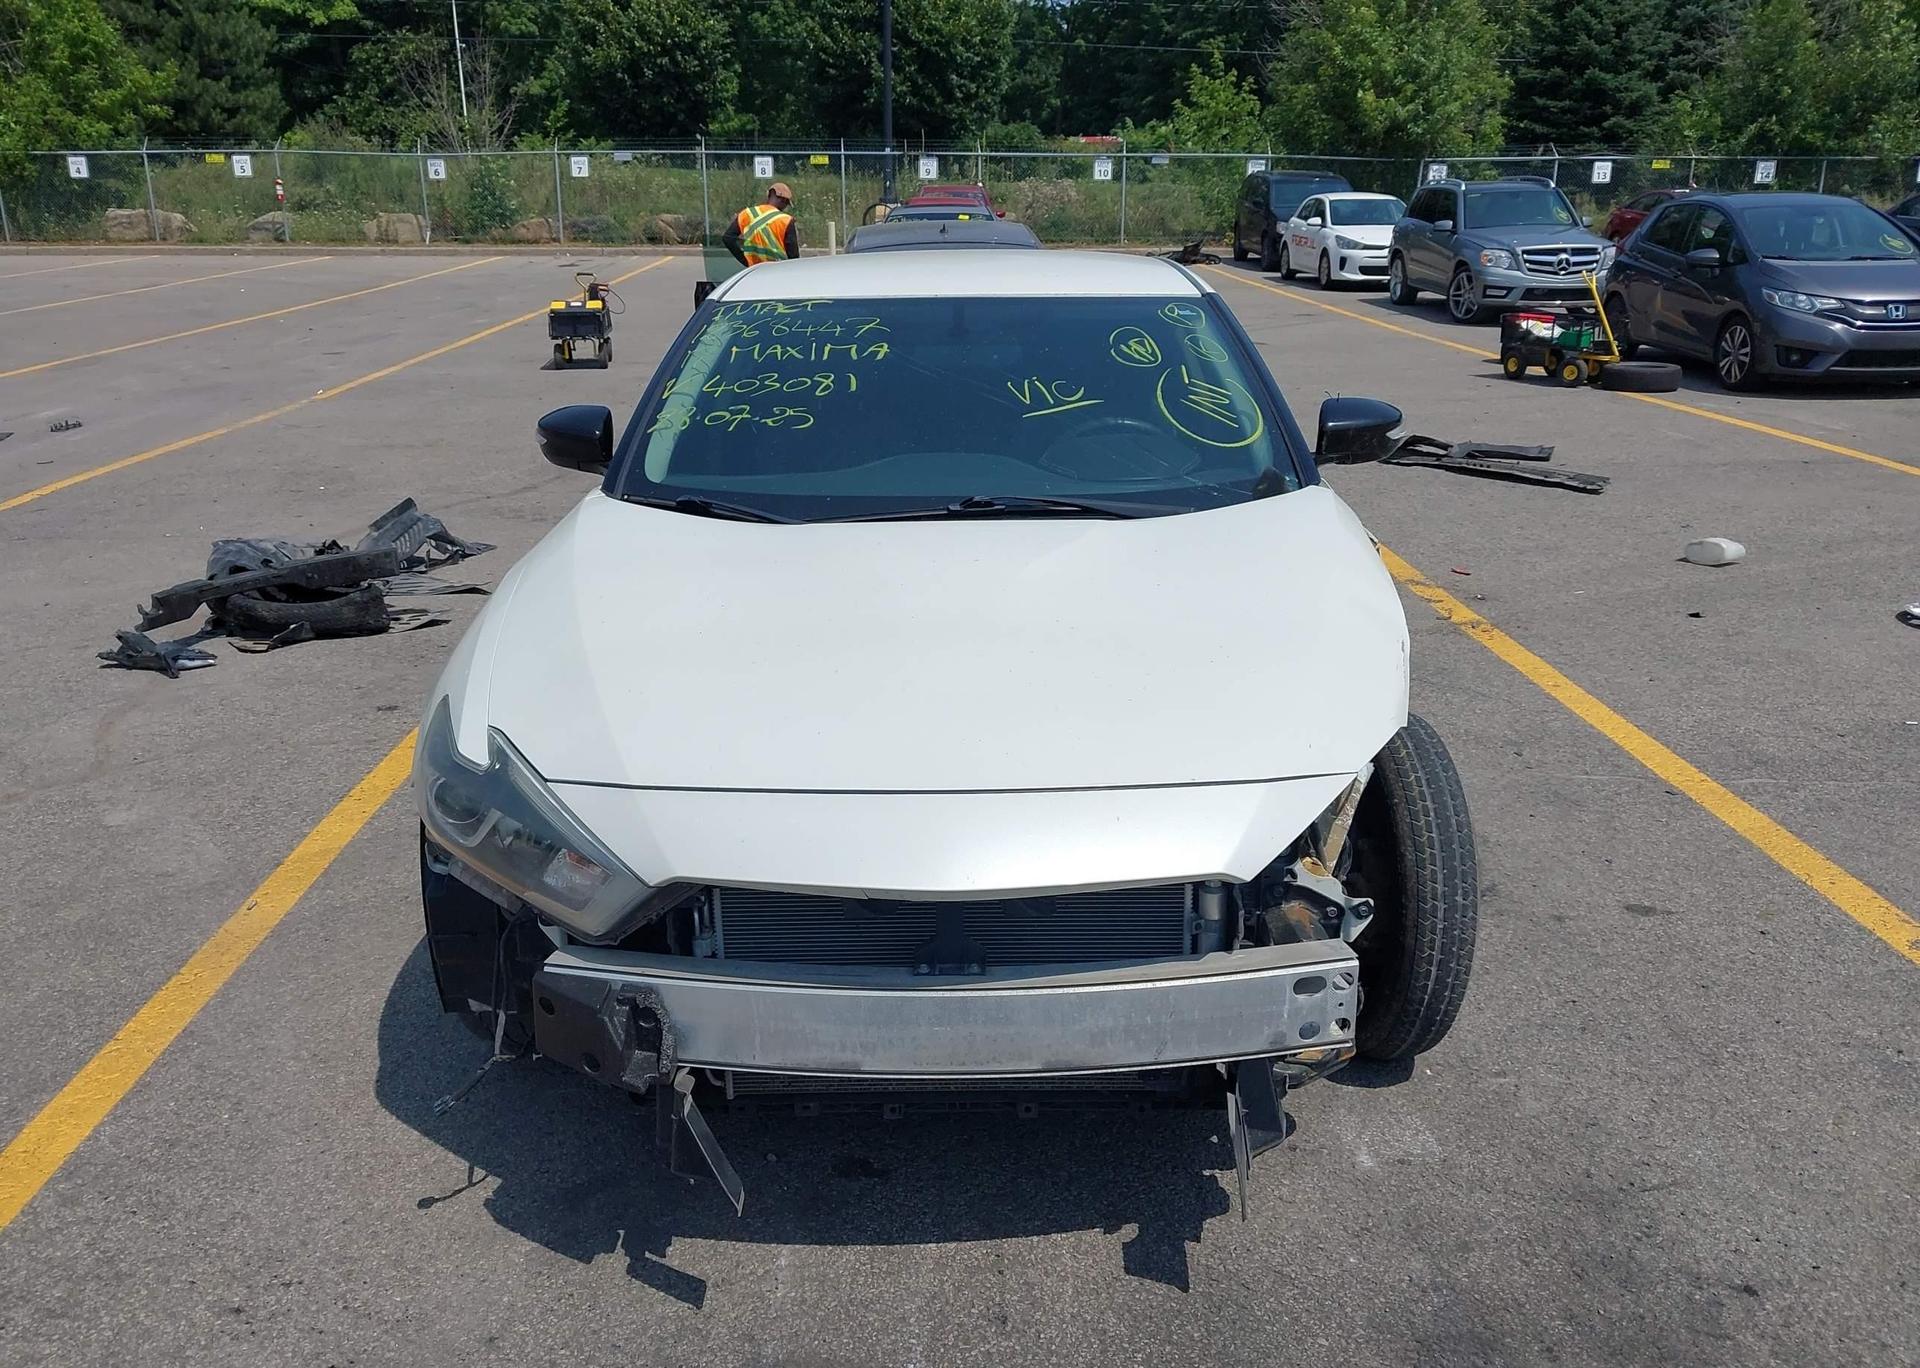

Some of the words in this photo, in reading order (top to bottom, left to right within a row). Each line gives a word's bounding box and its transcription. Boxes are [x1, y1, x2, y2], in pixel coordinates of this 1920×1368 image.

[75, 167, 81, 175] 4
[239, 165, 246, 174] 5
[434, 168, 440, 177] 6
[577, 166, 583, 175] 7
[760, 167, 767, 176] 8
[925, 168, 931, 176] 9
[1098, 169, 1109, 177] 10
[1596, 172, 1607, 180] 13
[729, 338, 891, 364] MAXIMA
